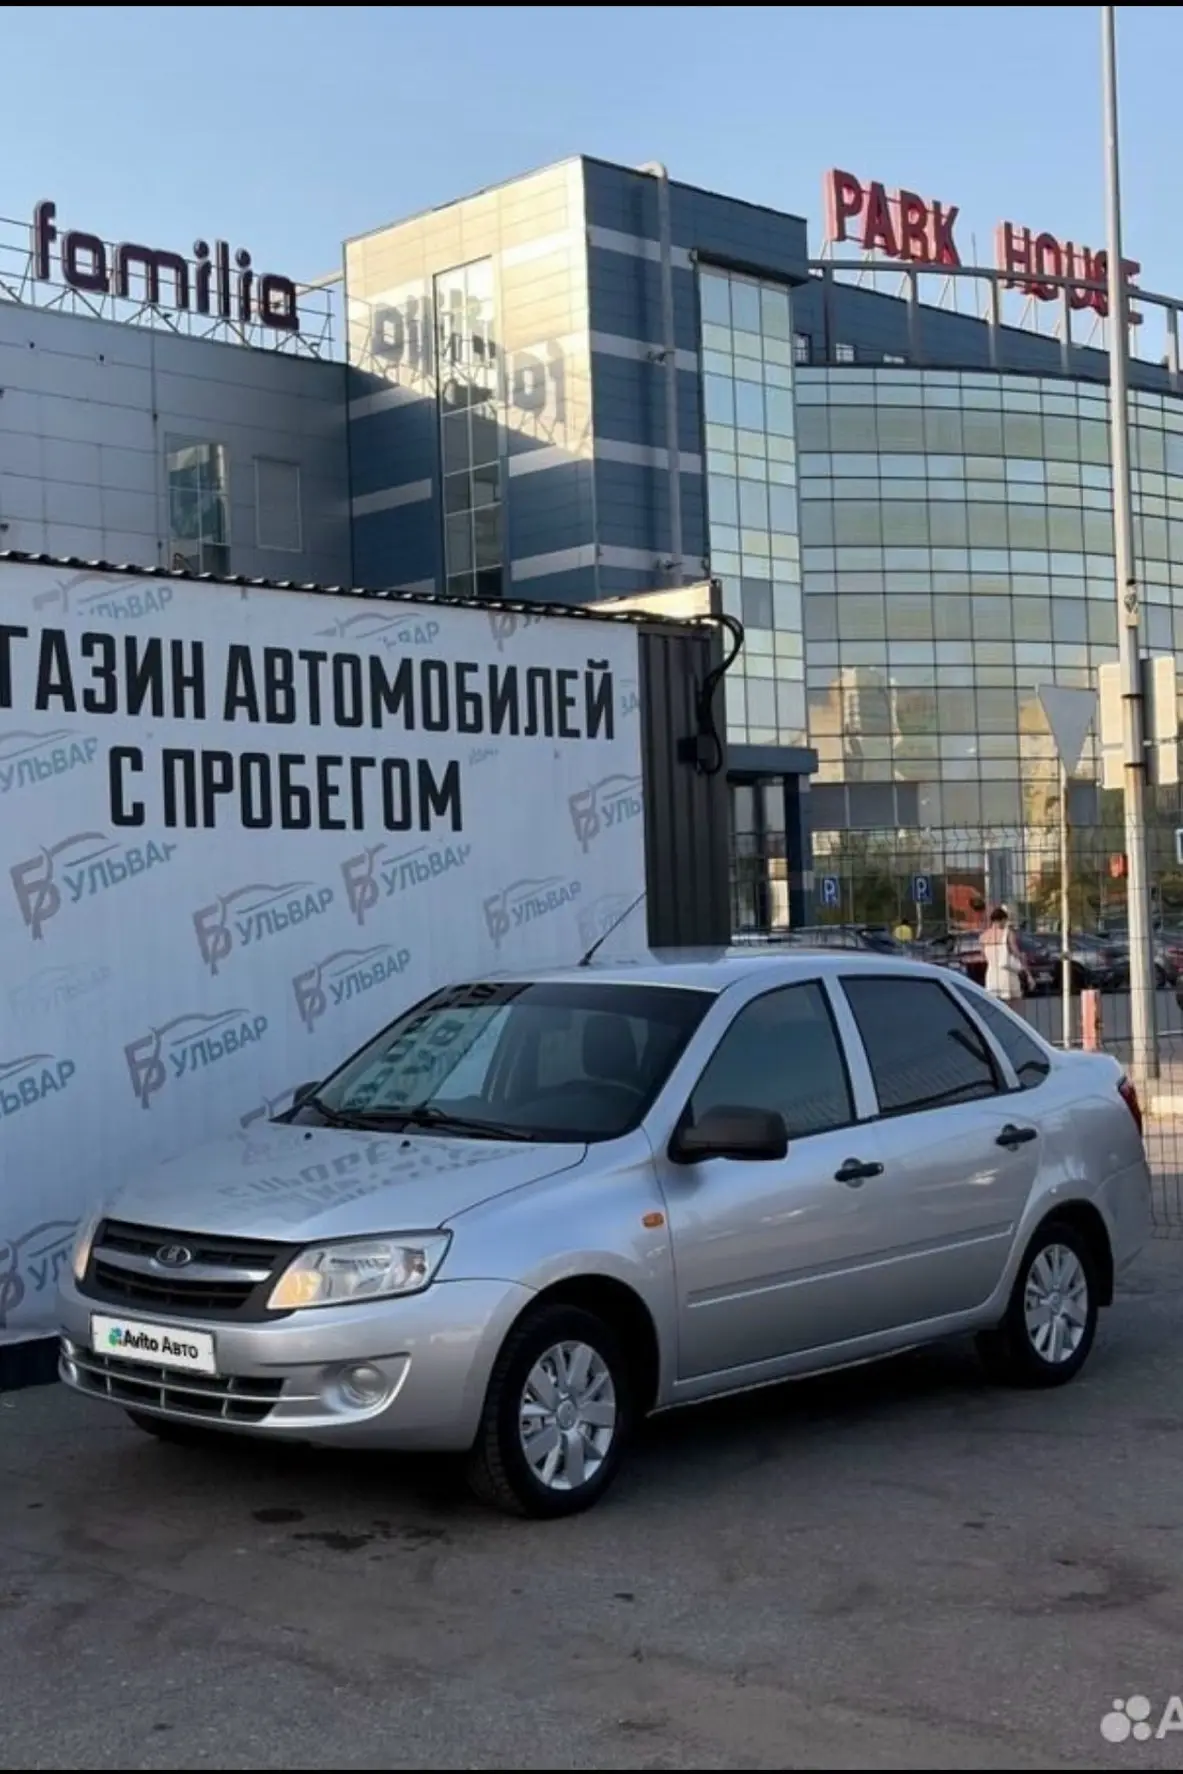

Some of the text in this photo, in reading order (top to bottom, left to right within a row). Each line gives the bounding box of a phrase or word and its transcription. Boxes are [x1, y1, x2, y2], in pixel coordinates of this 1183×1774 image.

[33, 199, 299, 331] familia
[823, 168, 962, 267] PARK
[223, 644, 614, 740] АВТОМОБИЛЕЙ
[108, 746, 463, 832] С ПРОБЕГОМ
